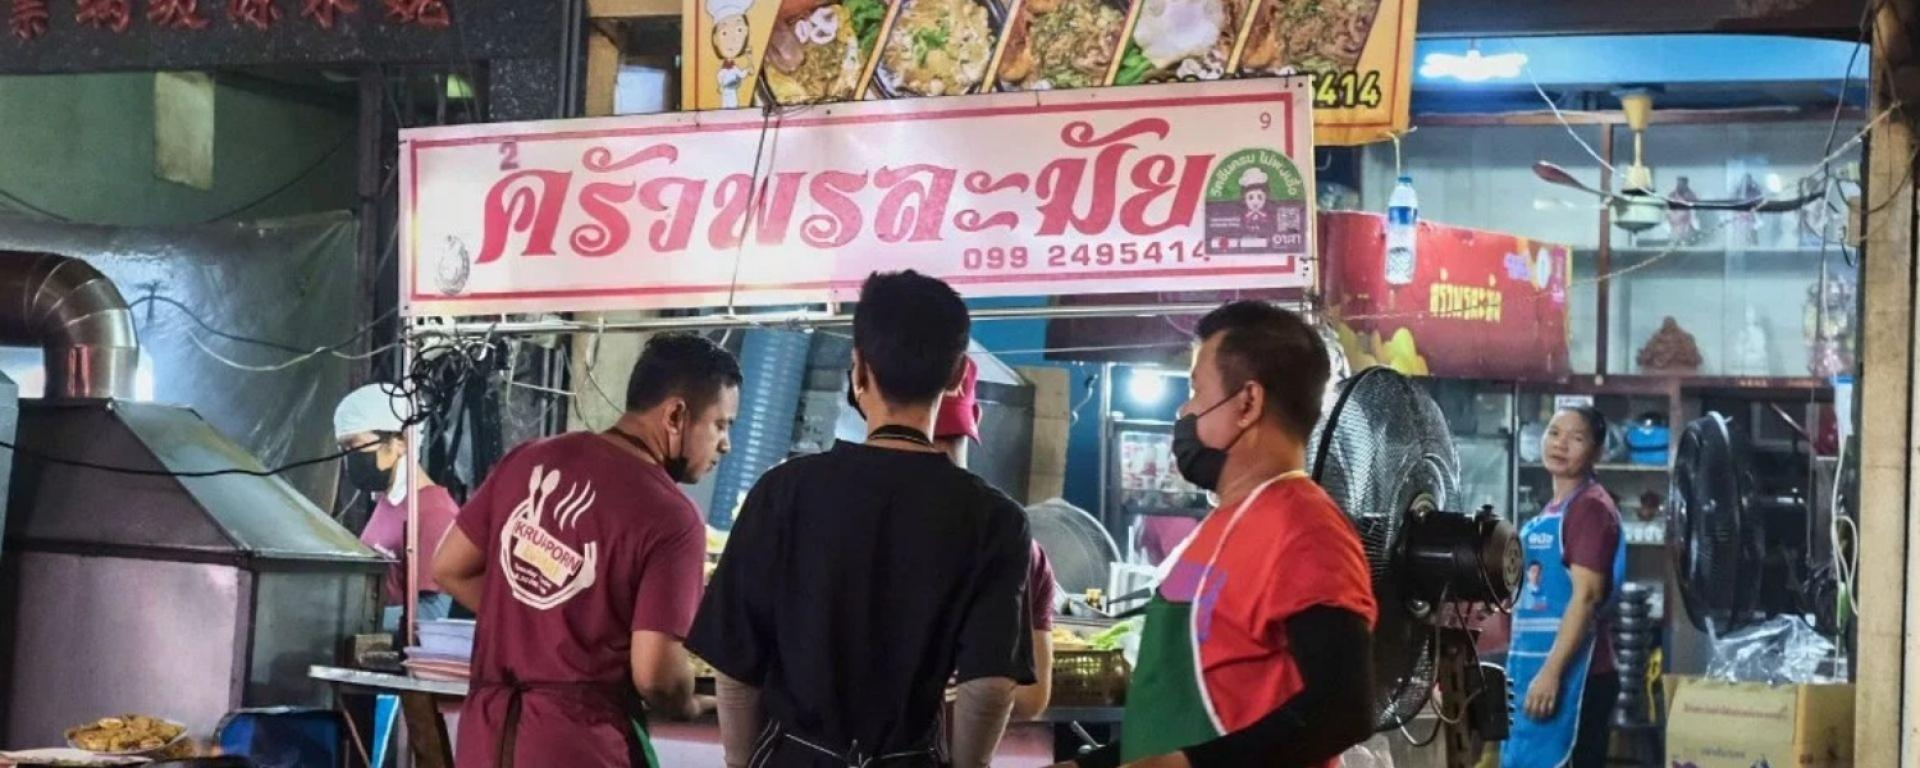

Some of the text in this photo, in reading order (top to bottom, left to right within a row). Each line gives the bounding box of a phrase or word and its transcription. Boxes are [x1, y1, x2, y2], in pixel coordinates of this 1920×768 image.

[1312, 71, 1381, 108] 414
[1258, 111, 1273, 130] 9
[500, 140, 519, 170] 2
[474, 117, 1216, 265] ครัวพรละมัย
[963, 246, 1029, 271] 099
